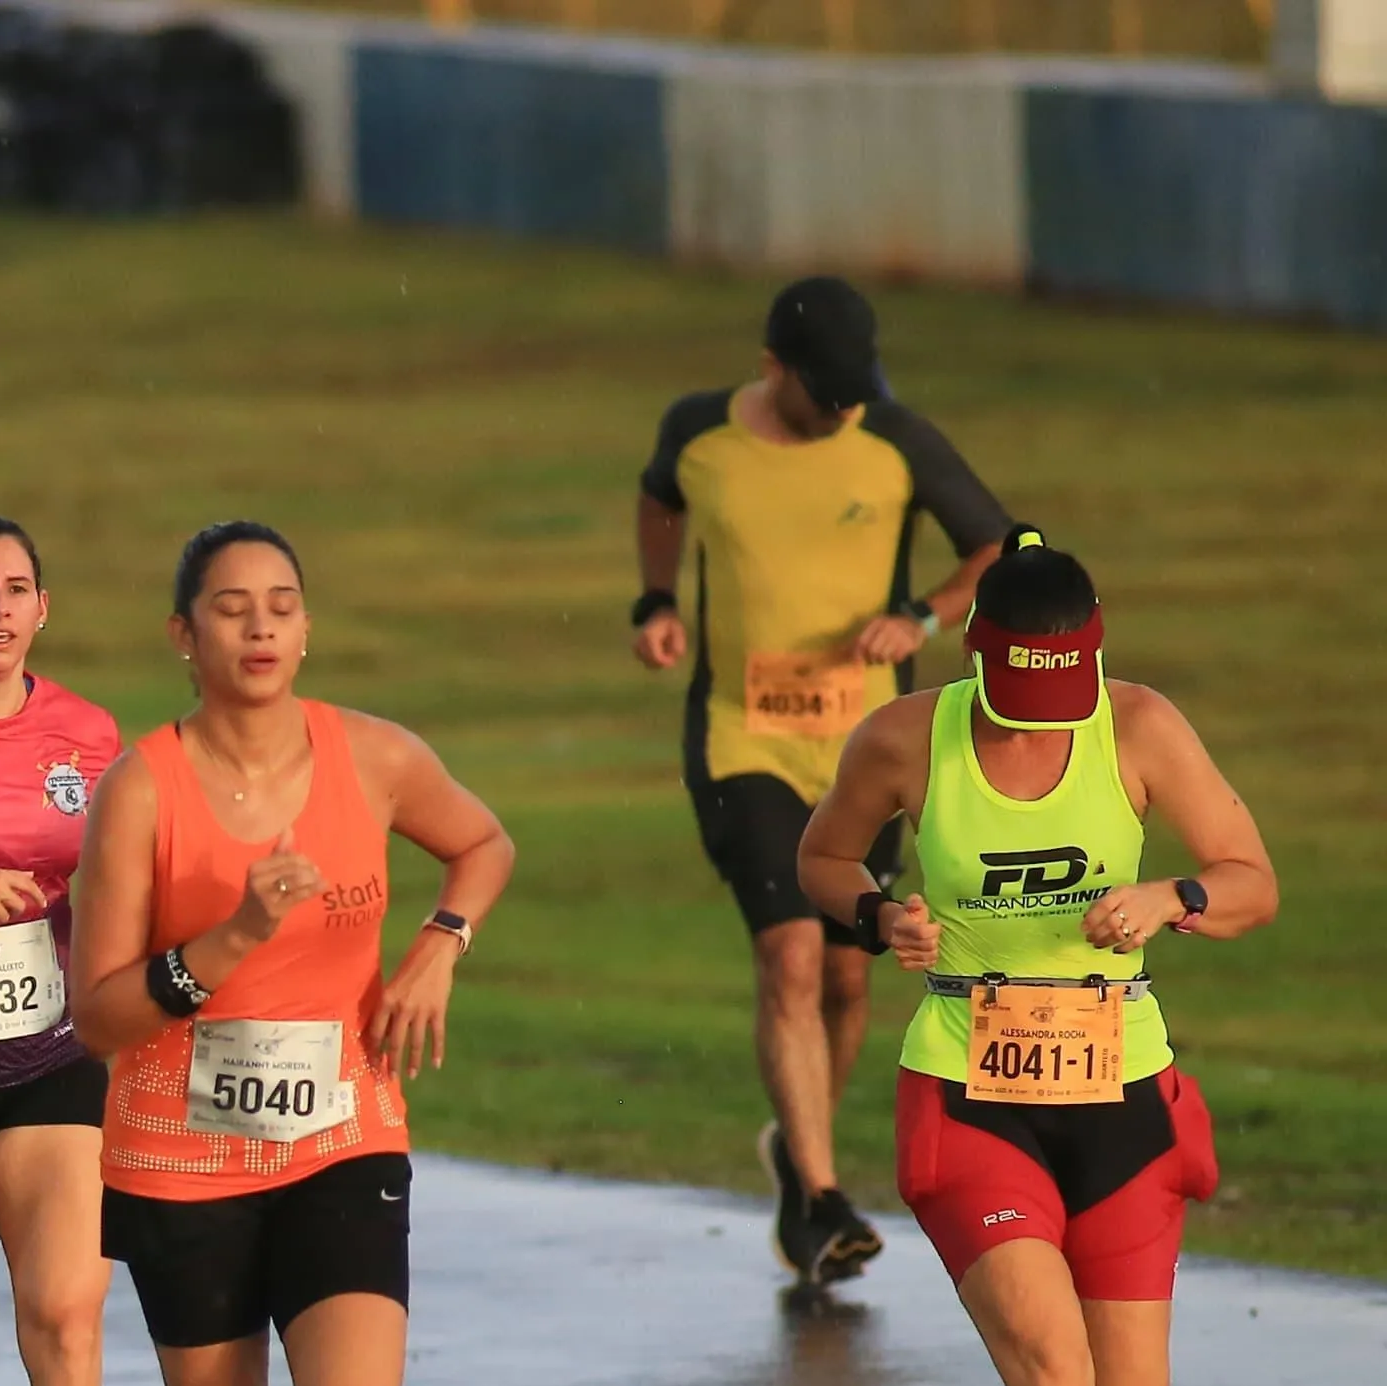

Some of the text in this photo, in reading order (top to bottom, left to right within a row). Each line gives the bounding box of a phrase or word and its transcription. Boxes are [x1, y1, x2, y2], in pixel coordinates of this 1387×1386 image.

[979, 846, 1088, 896] FD
[322, 873, 382, 911] start
[1000, 1028, 1086, 1039] ALESSANDRA ROCHA
[979, 1041, 1094, 1080] 4041-1
[212, 1073, 315, 1116] 5040
